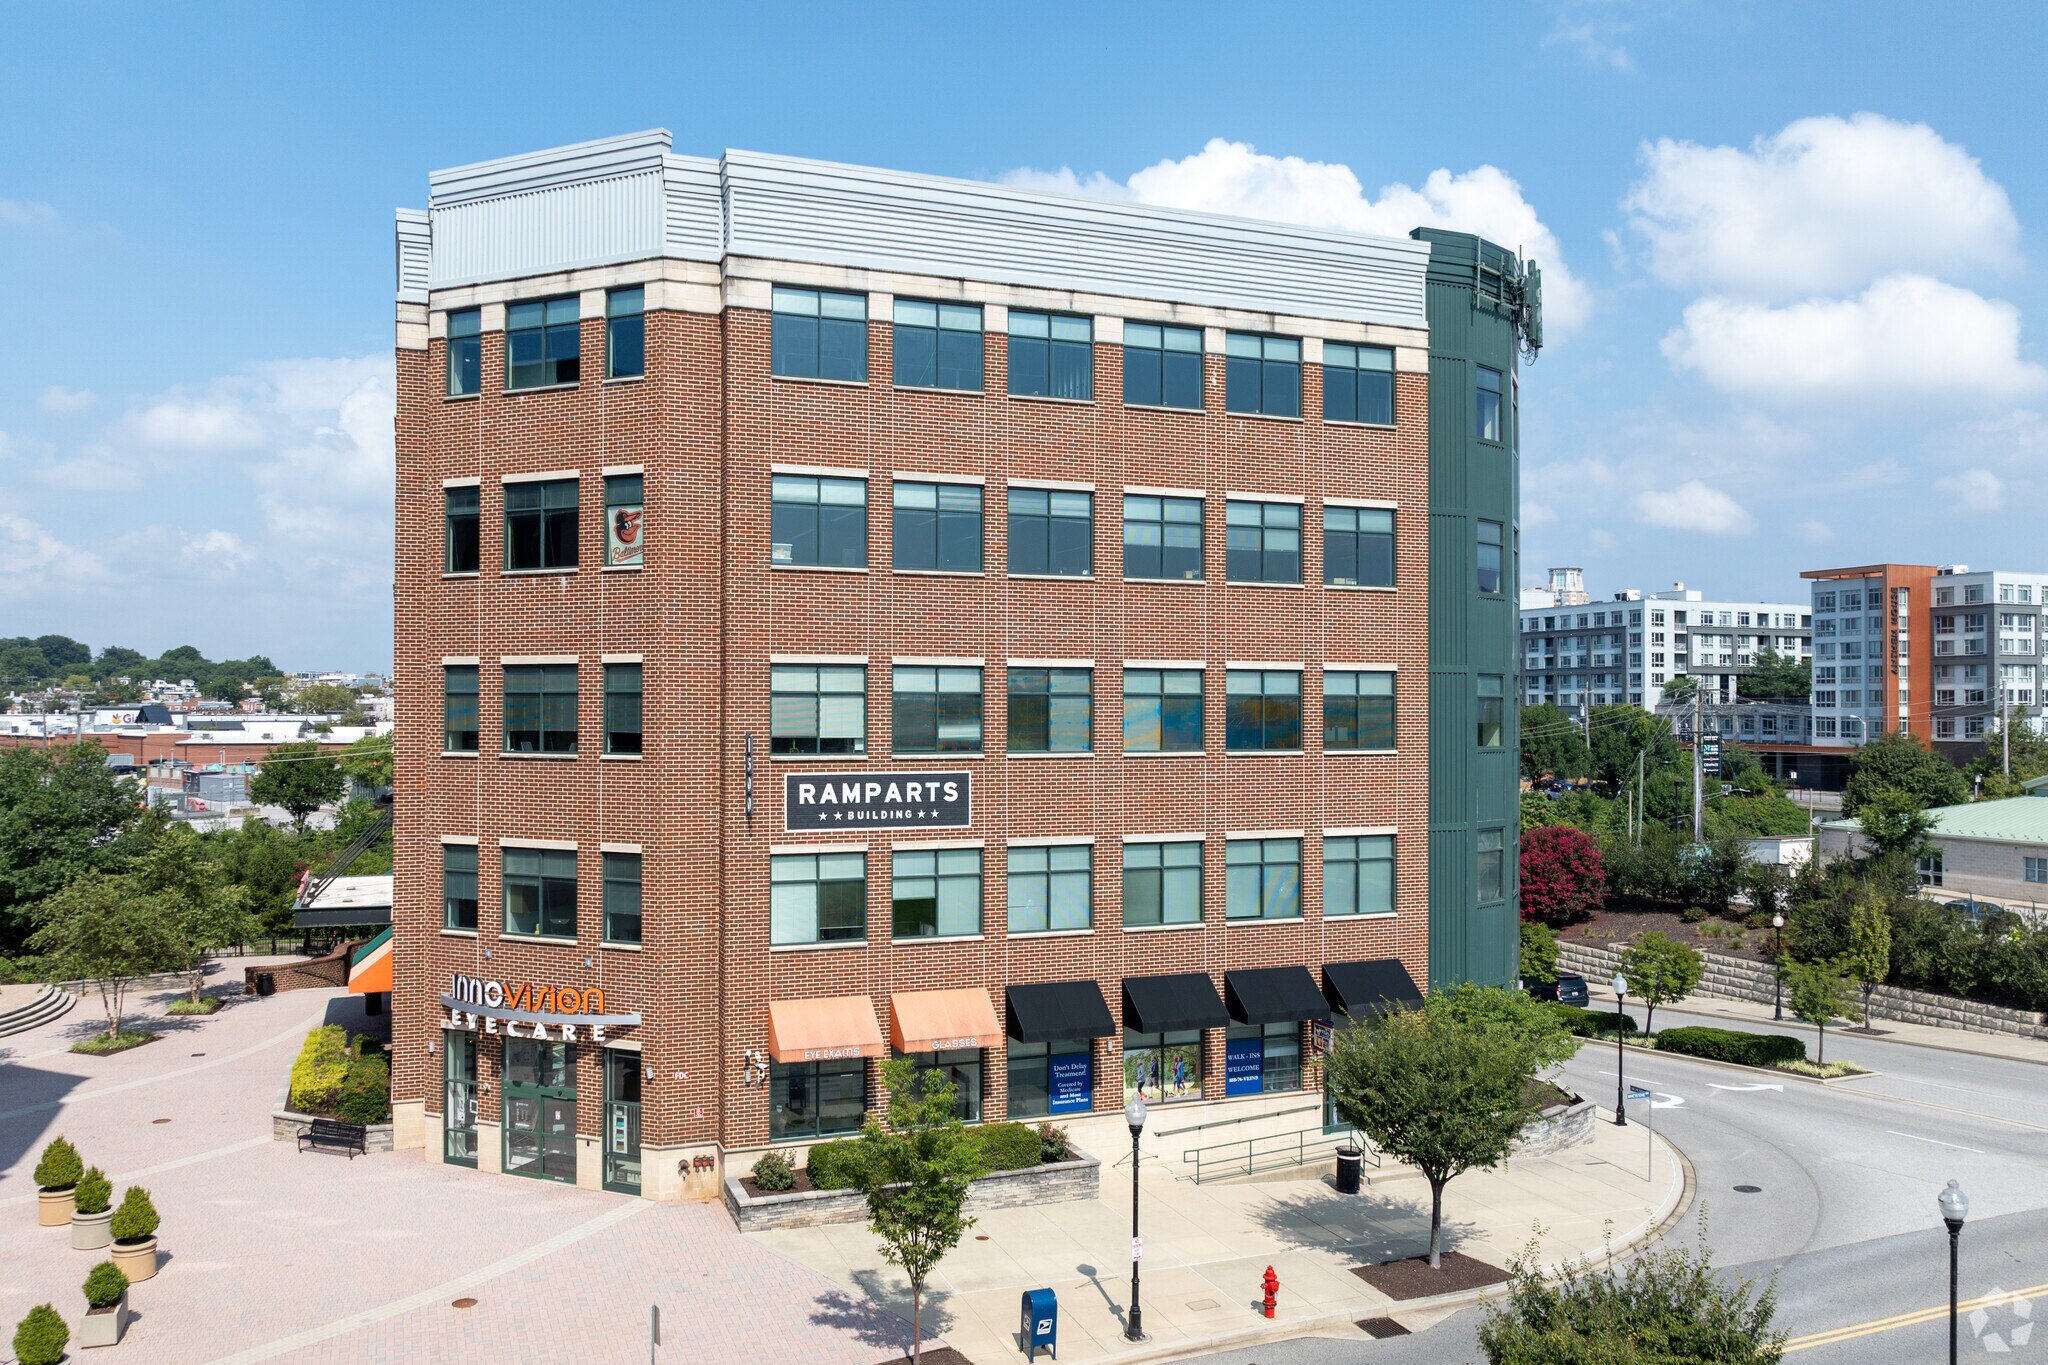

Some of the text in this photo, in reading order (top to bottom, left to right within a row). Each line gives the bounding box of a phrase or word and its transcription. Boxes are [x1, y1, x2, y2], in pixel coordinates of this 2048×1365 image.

[799, 781, 959, 805] RAMPARTS
[847, 809, 912, 820] BUILDING
[451, 1009, 606, 1042] EYECARE
[931, 1038, 977, 1049] GLASSES
[804, 1047, 860, 1060] EYE EXAMS
[675, 1072, 689, 1080] FDC
[1055, 1069, 1086, 1078] Treatment!
